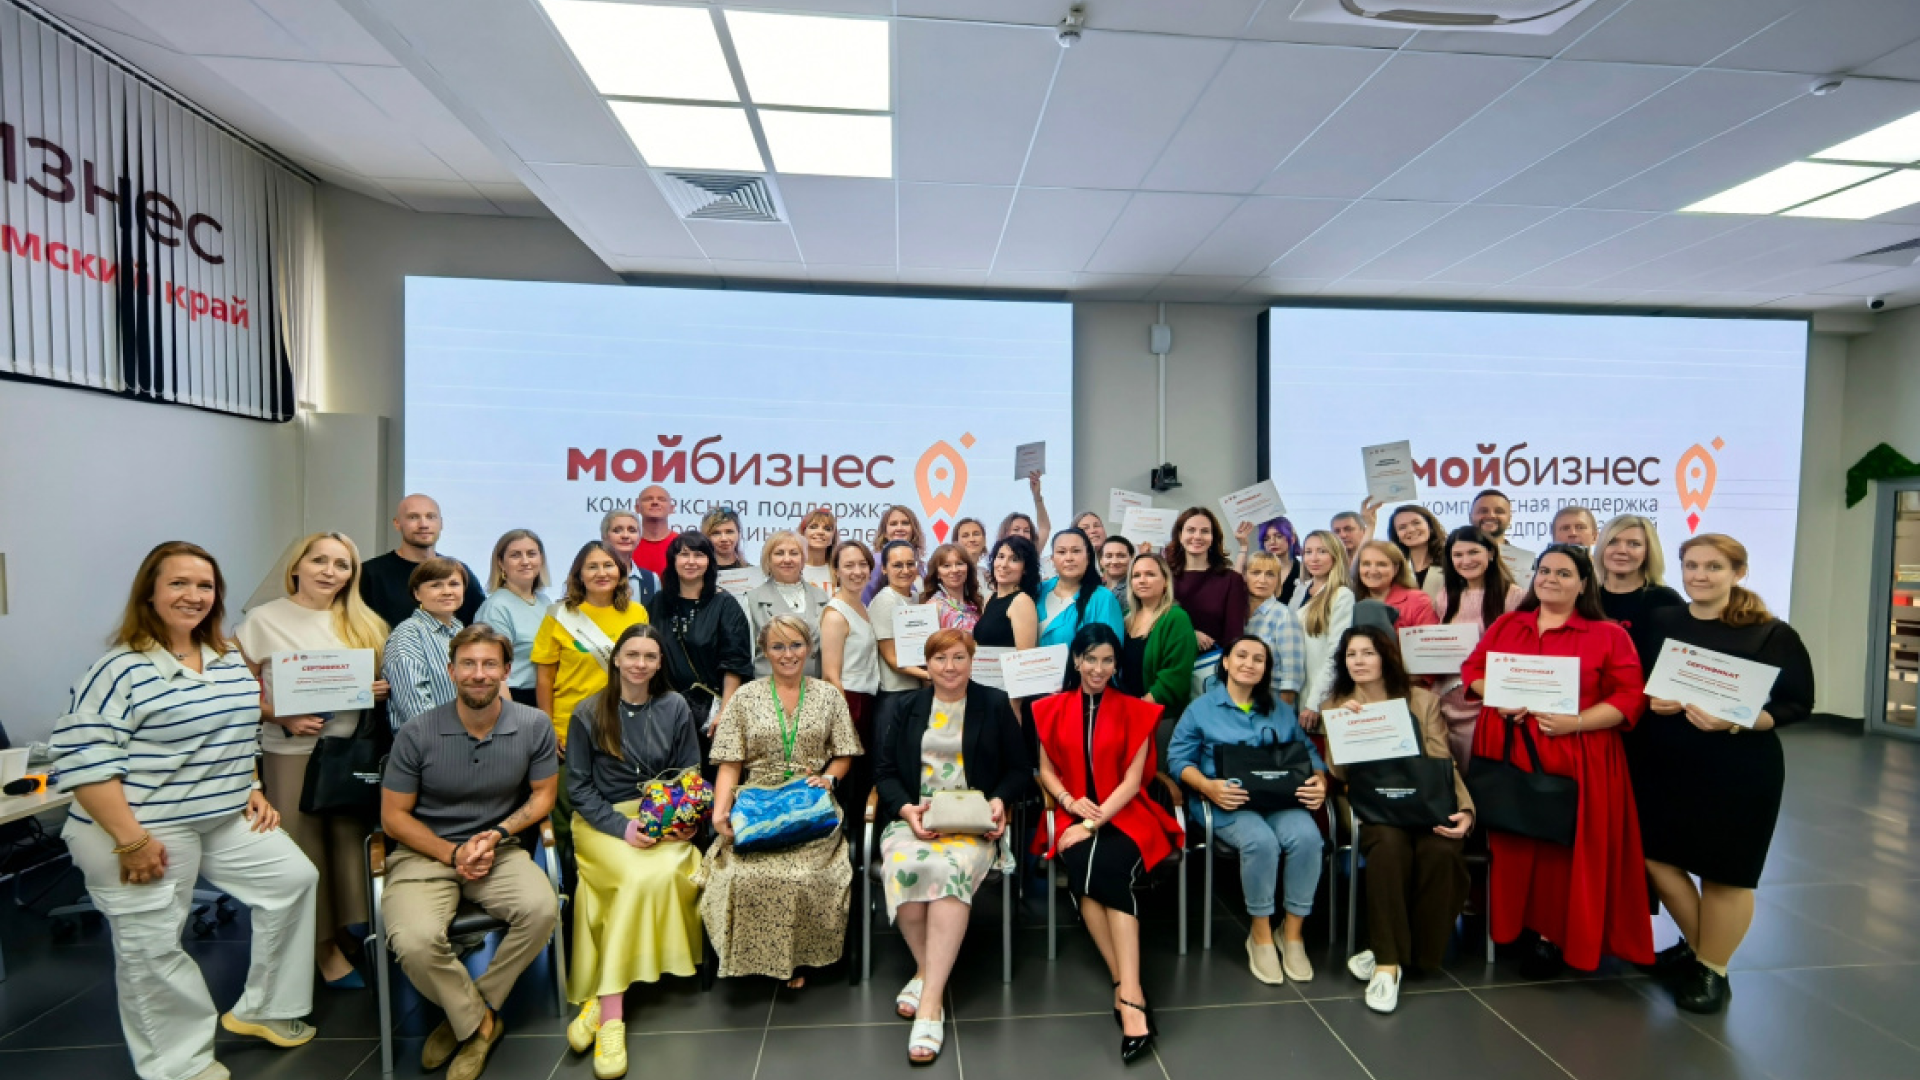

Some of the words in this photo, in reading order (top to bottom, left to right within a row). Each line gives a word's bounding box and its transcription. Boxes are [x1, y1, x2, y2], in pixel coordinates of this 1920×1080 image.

[164, 281, 249, 329] край
[567, 434, 895, 489] мойбизнес
[757, 501, 893, 522] подержк
[1685, 660, 1740, 679] СЕРТИФИКАТ
